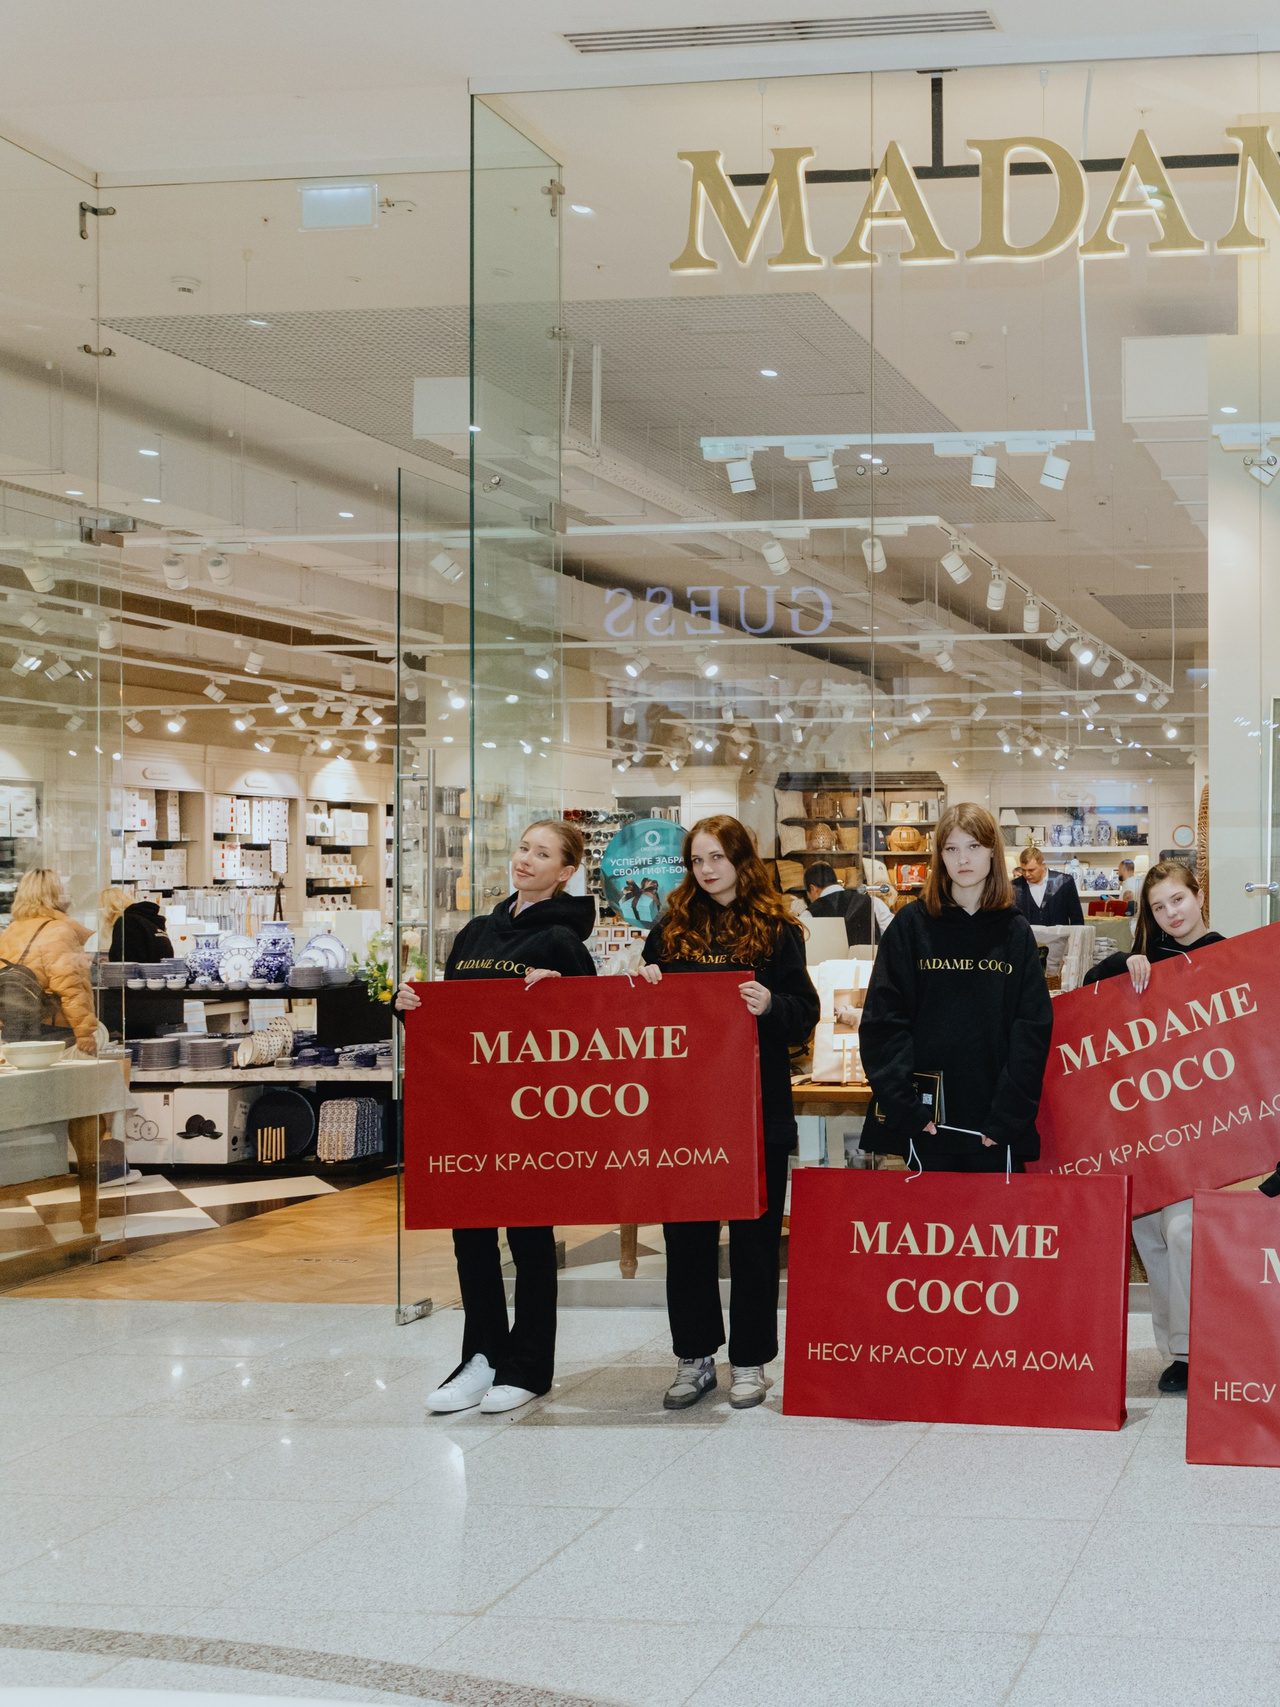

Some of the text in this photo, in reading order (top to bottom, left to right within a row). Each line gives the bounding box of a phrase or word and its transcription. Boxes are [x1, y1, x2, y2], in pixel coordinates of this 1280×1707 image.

[610, 856, 653, 866] УСПЕЙТЕ
[613, 866, 640, 876] СВОЙ
[978, 959, 1013, 975] COCO
[469, 1025, 689, 1065] MADAME
[1055, 982, 1258, 1076] MADAME
[1109, 1047, 1235, 1112] COCO
[511, 1082, 649, 1120] COCO
[1109, 1120, 1203, 1166] КРАСОТУ
[1211, 1105, 1253, 1136] ДЛЯ
[428, 1147, 729, 1173] НЕСУ КРАСОТУ ДЛЯ ДОМА
[850, 1221, 1060, 1259] MADAME
[886, 1278, 1019, 1316] COCO
[807, 1342, 1094, 1372] НЕСУ КРАСОТУ ДЛЯ ДОМА
[1213, 1381, 1277, 1403] НЕСУ
